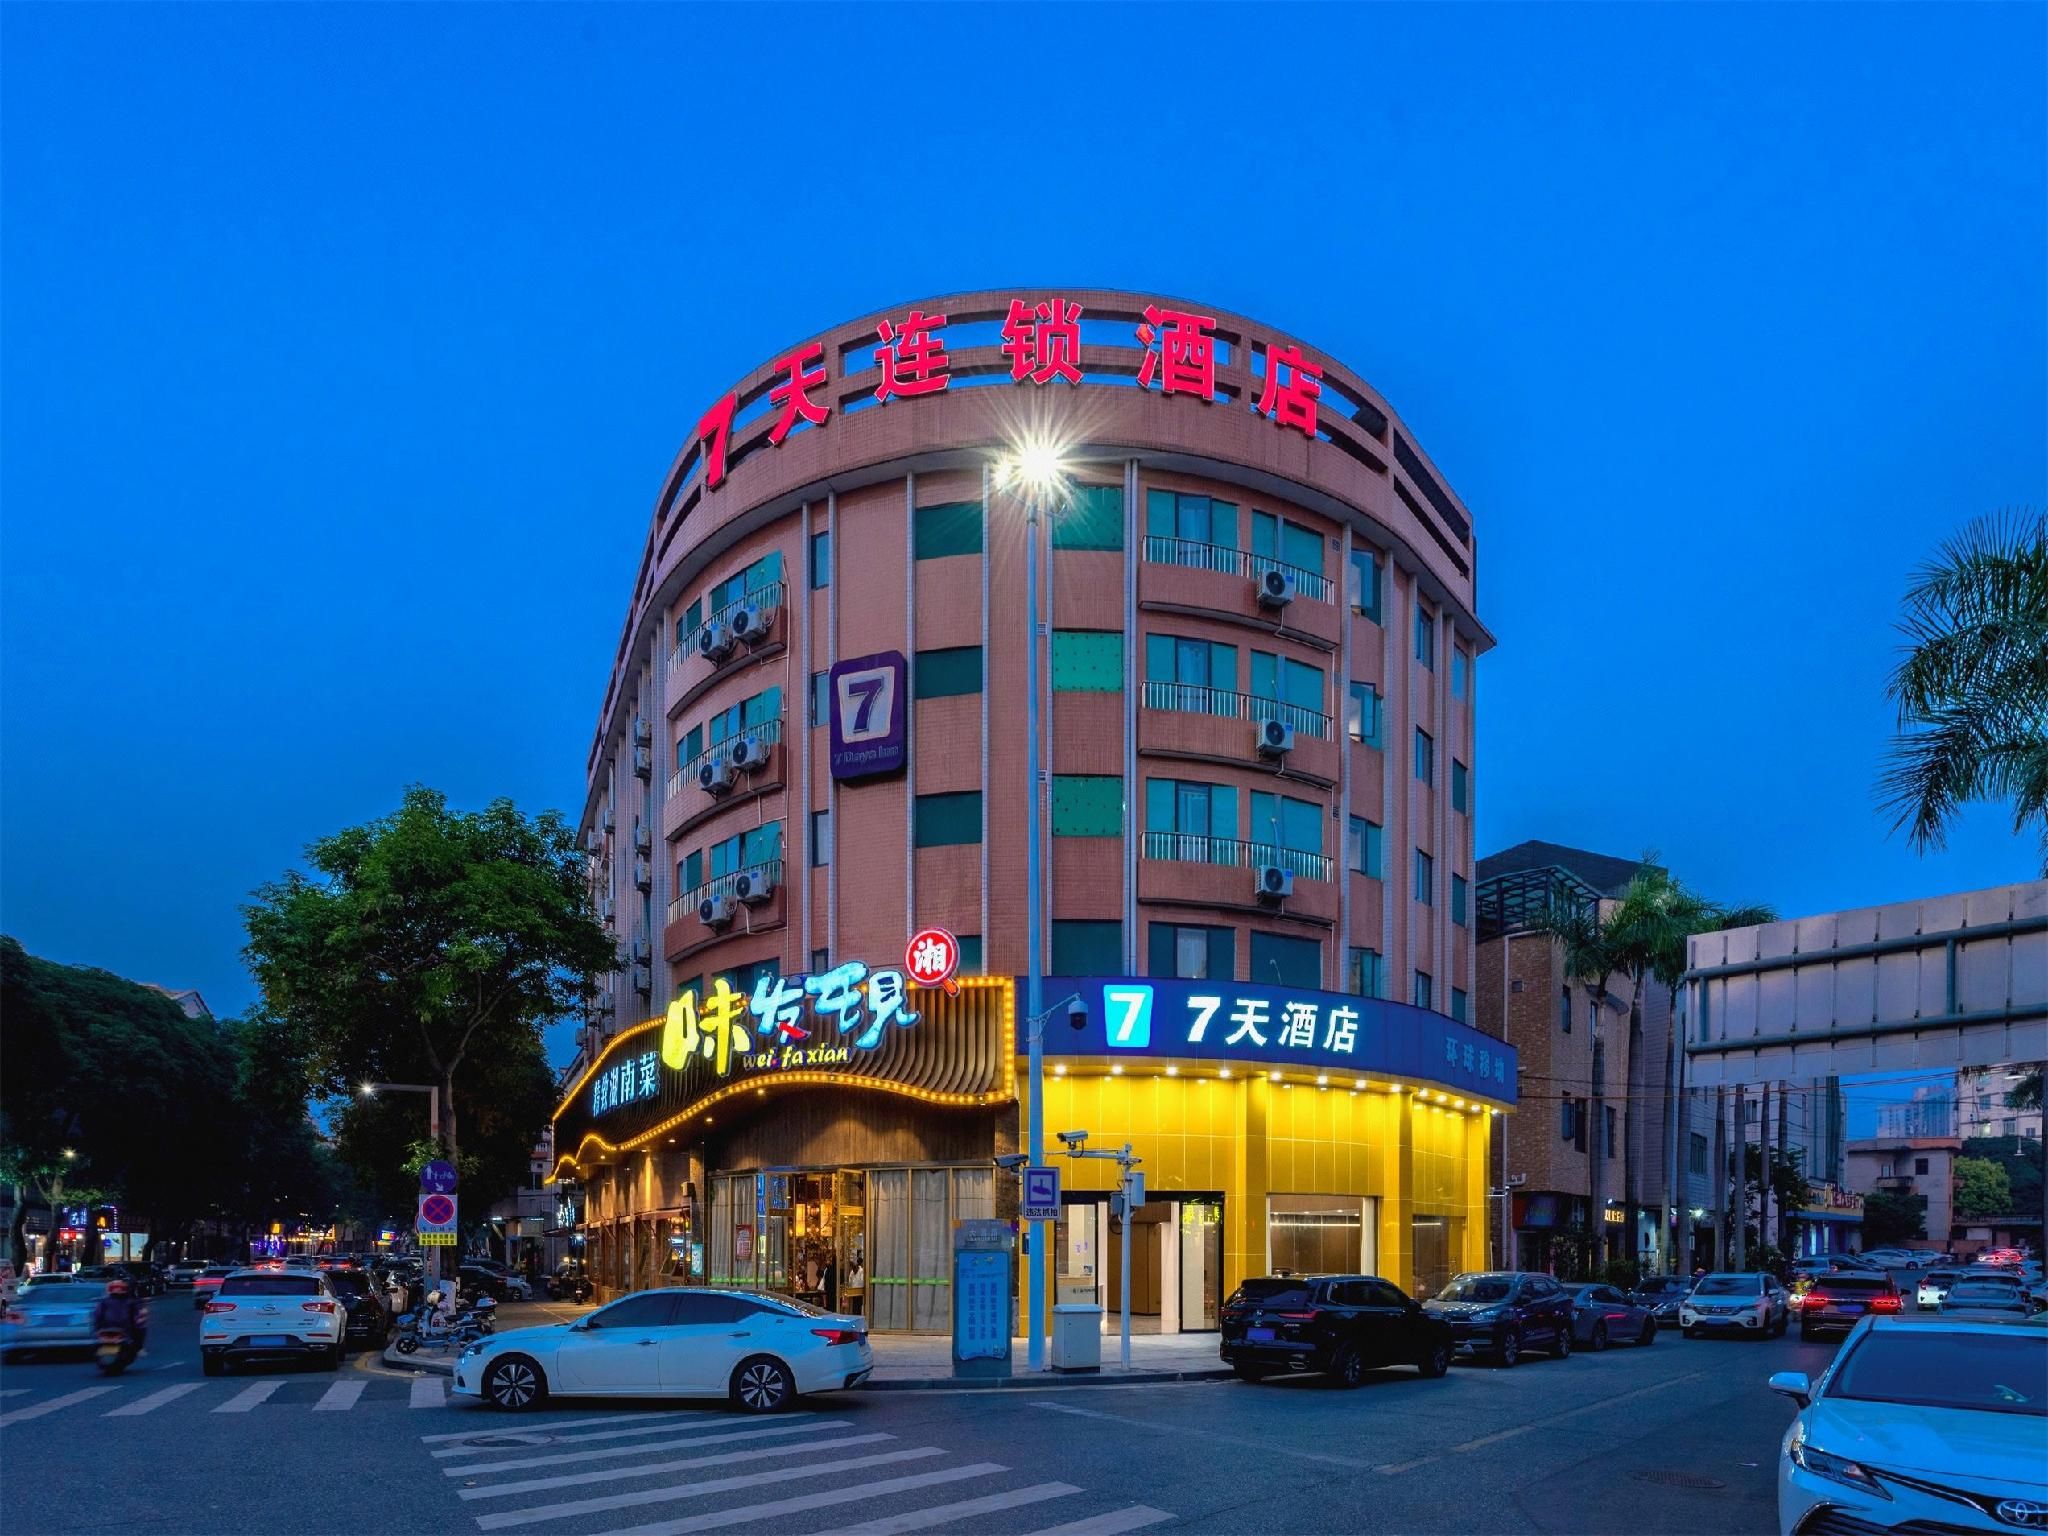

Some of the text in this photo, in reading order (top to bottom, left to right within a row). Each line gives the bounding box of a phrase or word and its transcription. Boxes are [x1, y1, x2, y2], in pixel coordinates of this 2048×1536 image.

[700, 298, 1323, 490] 7天连锁酒店
[848, 677, 884, 734] 7
[913, 938, 947, 975] 湘
[1109, 992, 1147, 1042] 7
[1187, 996, 1360, 1053] 7天酒店
[743, 1042, 849, 1069] wei fa xian
